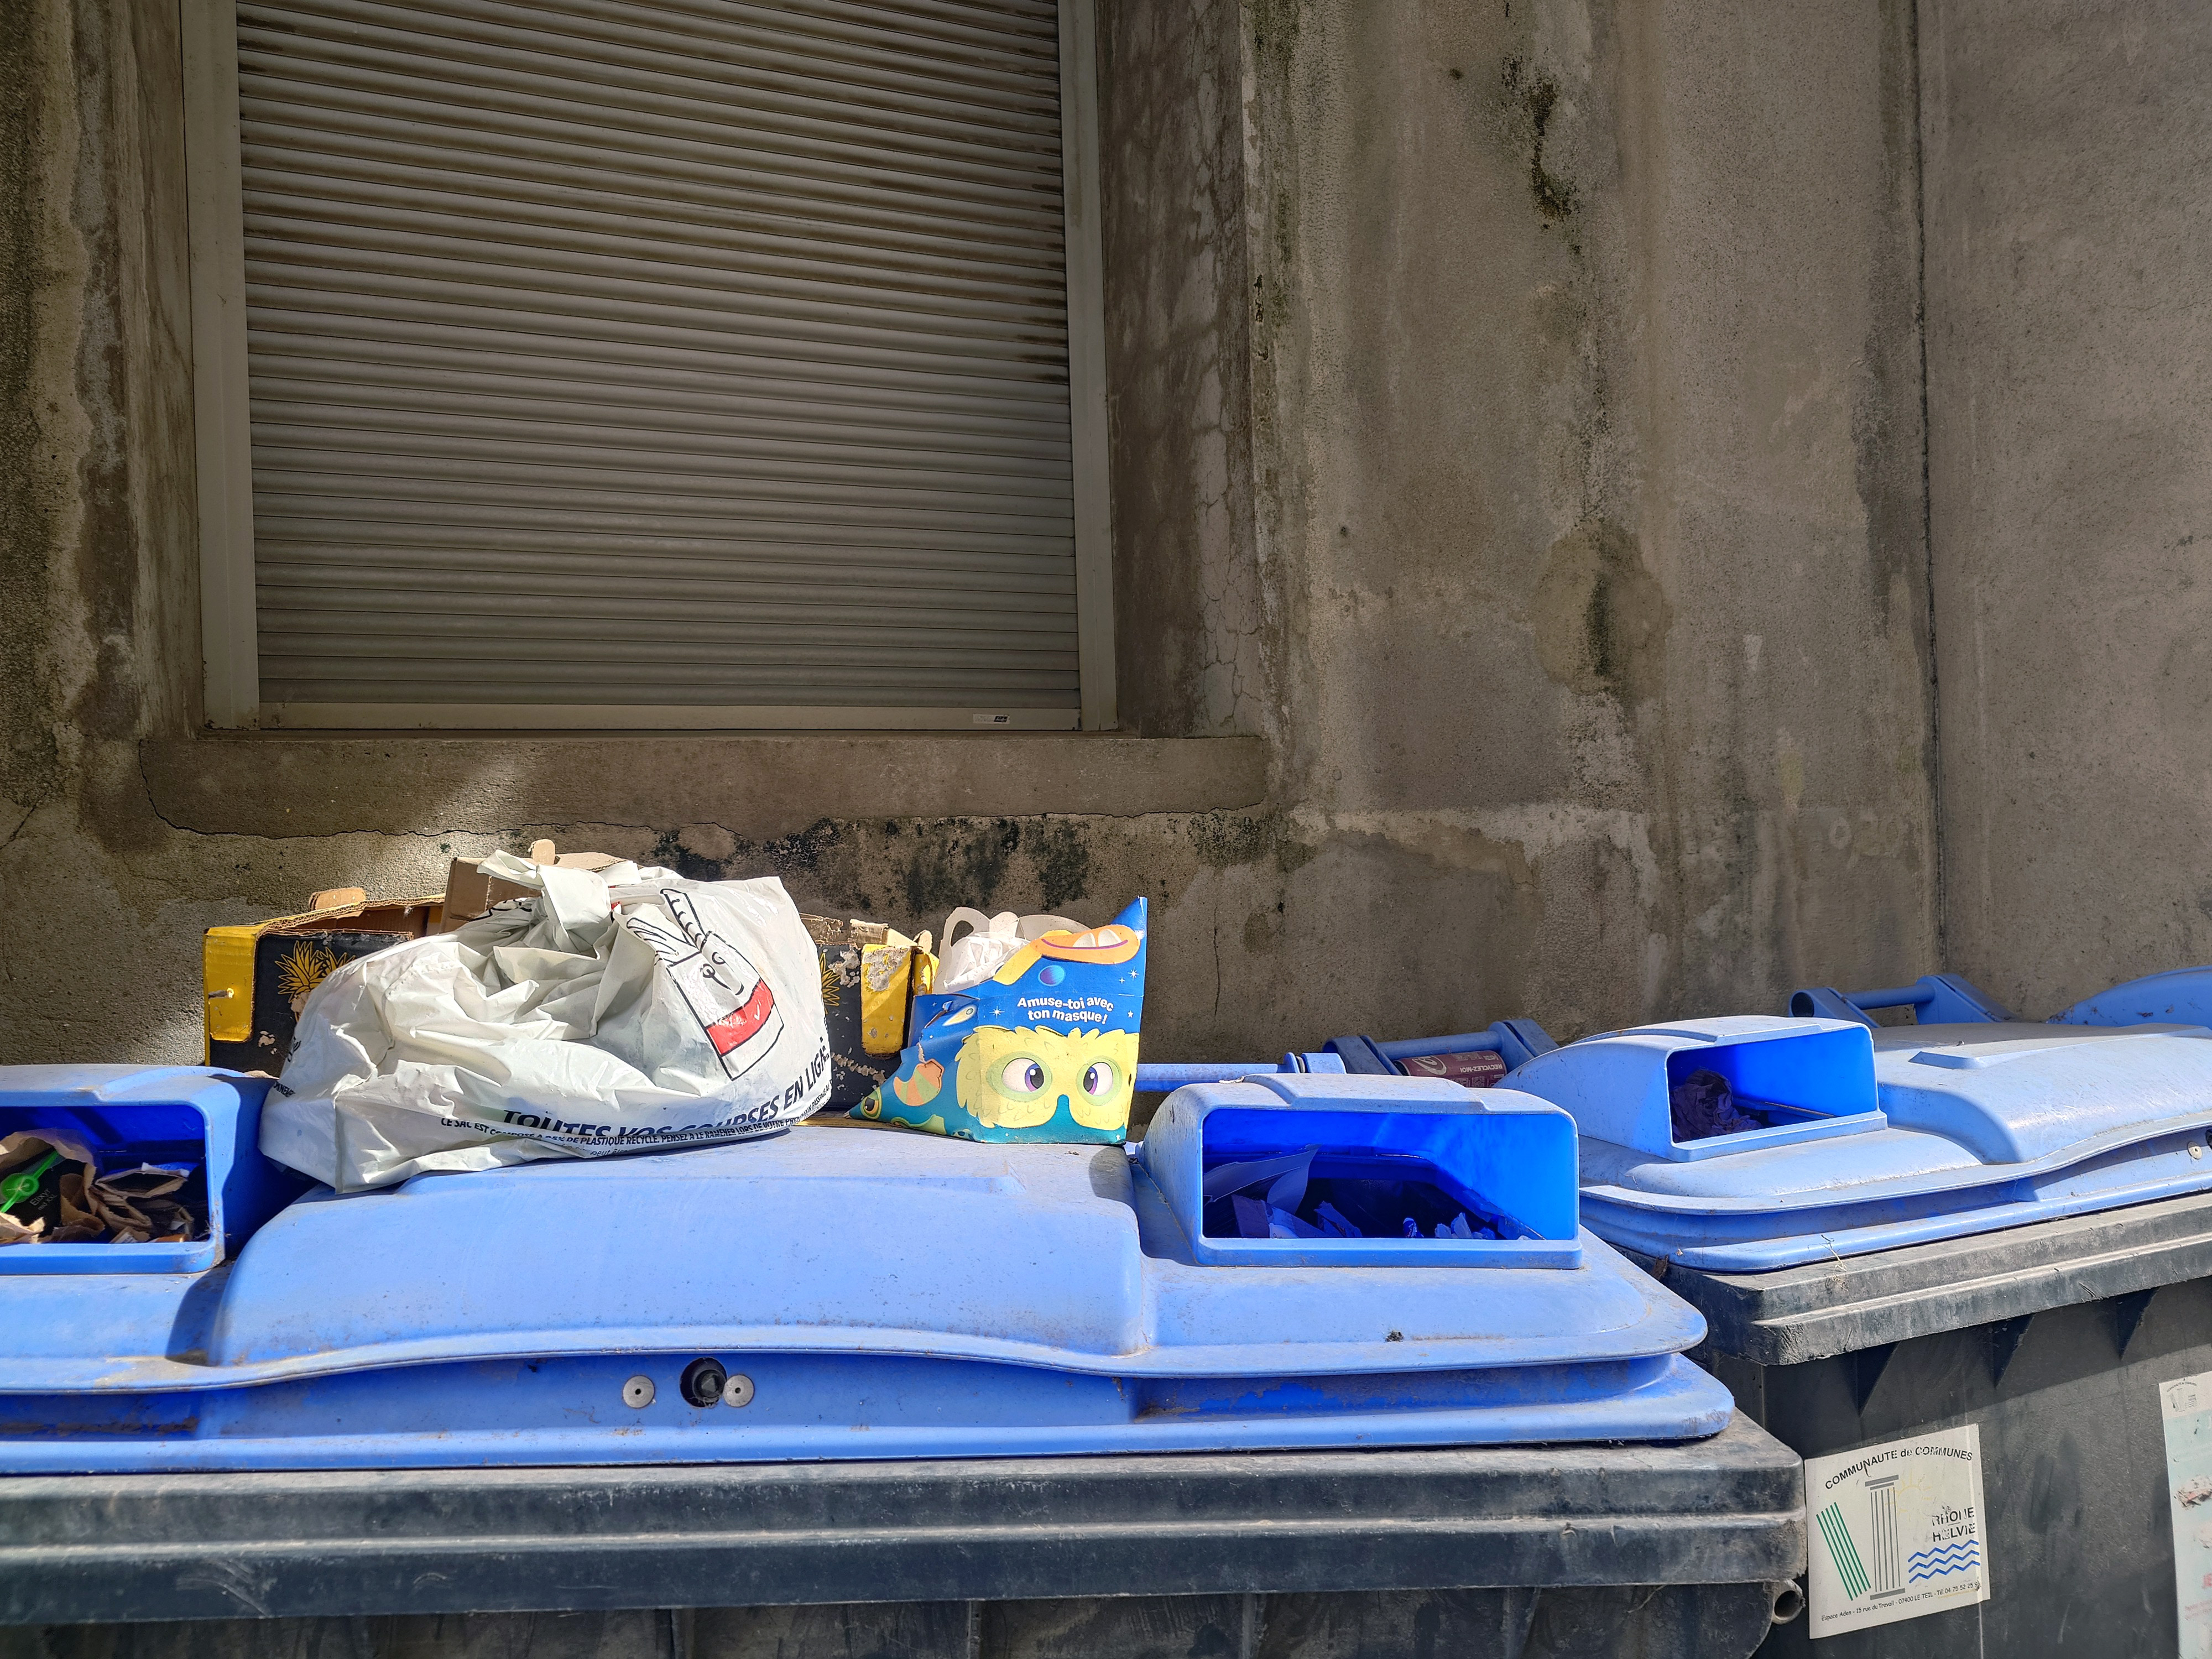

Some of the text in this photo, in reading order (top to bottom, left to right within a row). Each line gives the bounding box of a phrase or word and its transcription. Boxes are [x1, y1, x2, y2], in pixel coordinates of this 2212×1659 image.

[1017, 997, 1114, 1011] Amuse-toi avec
[1028, 1010, 1050, 1021] ton
[1460, 1063, 1503, 1073] RECYCLEZ-MOI
[784, 1075, 804, 1111] EN
[441, 1118, 453, 1127] CE
[474, 1124, 489, 1135] EST
[580, 1136, 624, 1146] PLASTIQUE
[661, 1133, 688, 1143] PENSEZ
[1825, 1449, 1898, 1490] COMMUNAUTE
[1915, 1446, 1973, 1462] COMMUNES
[1821, 1613, 1838, 1621] Espace
[1879, 1600, 1894, 1609] Travail
[1898, 1596, 1913, 1605] 07400
